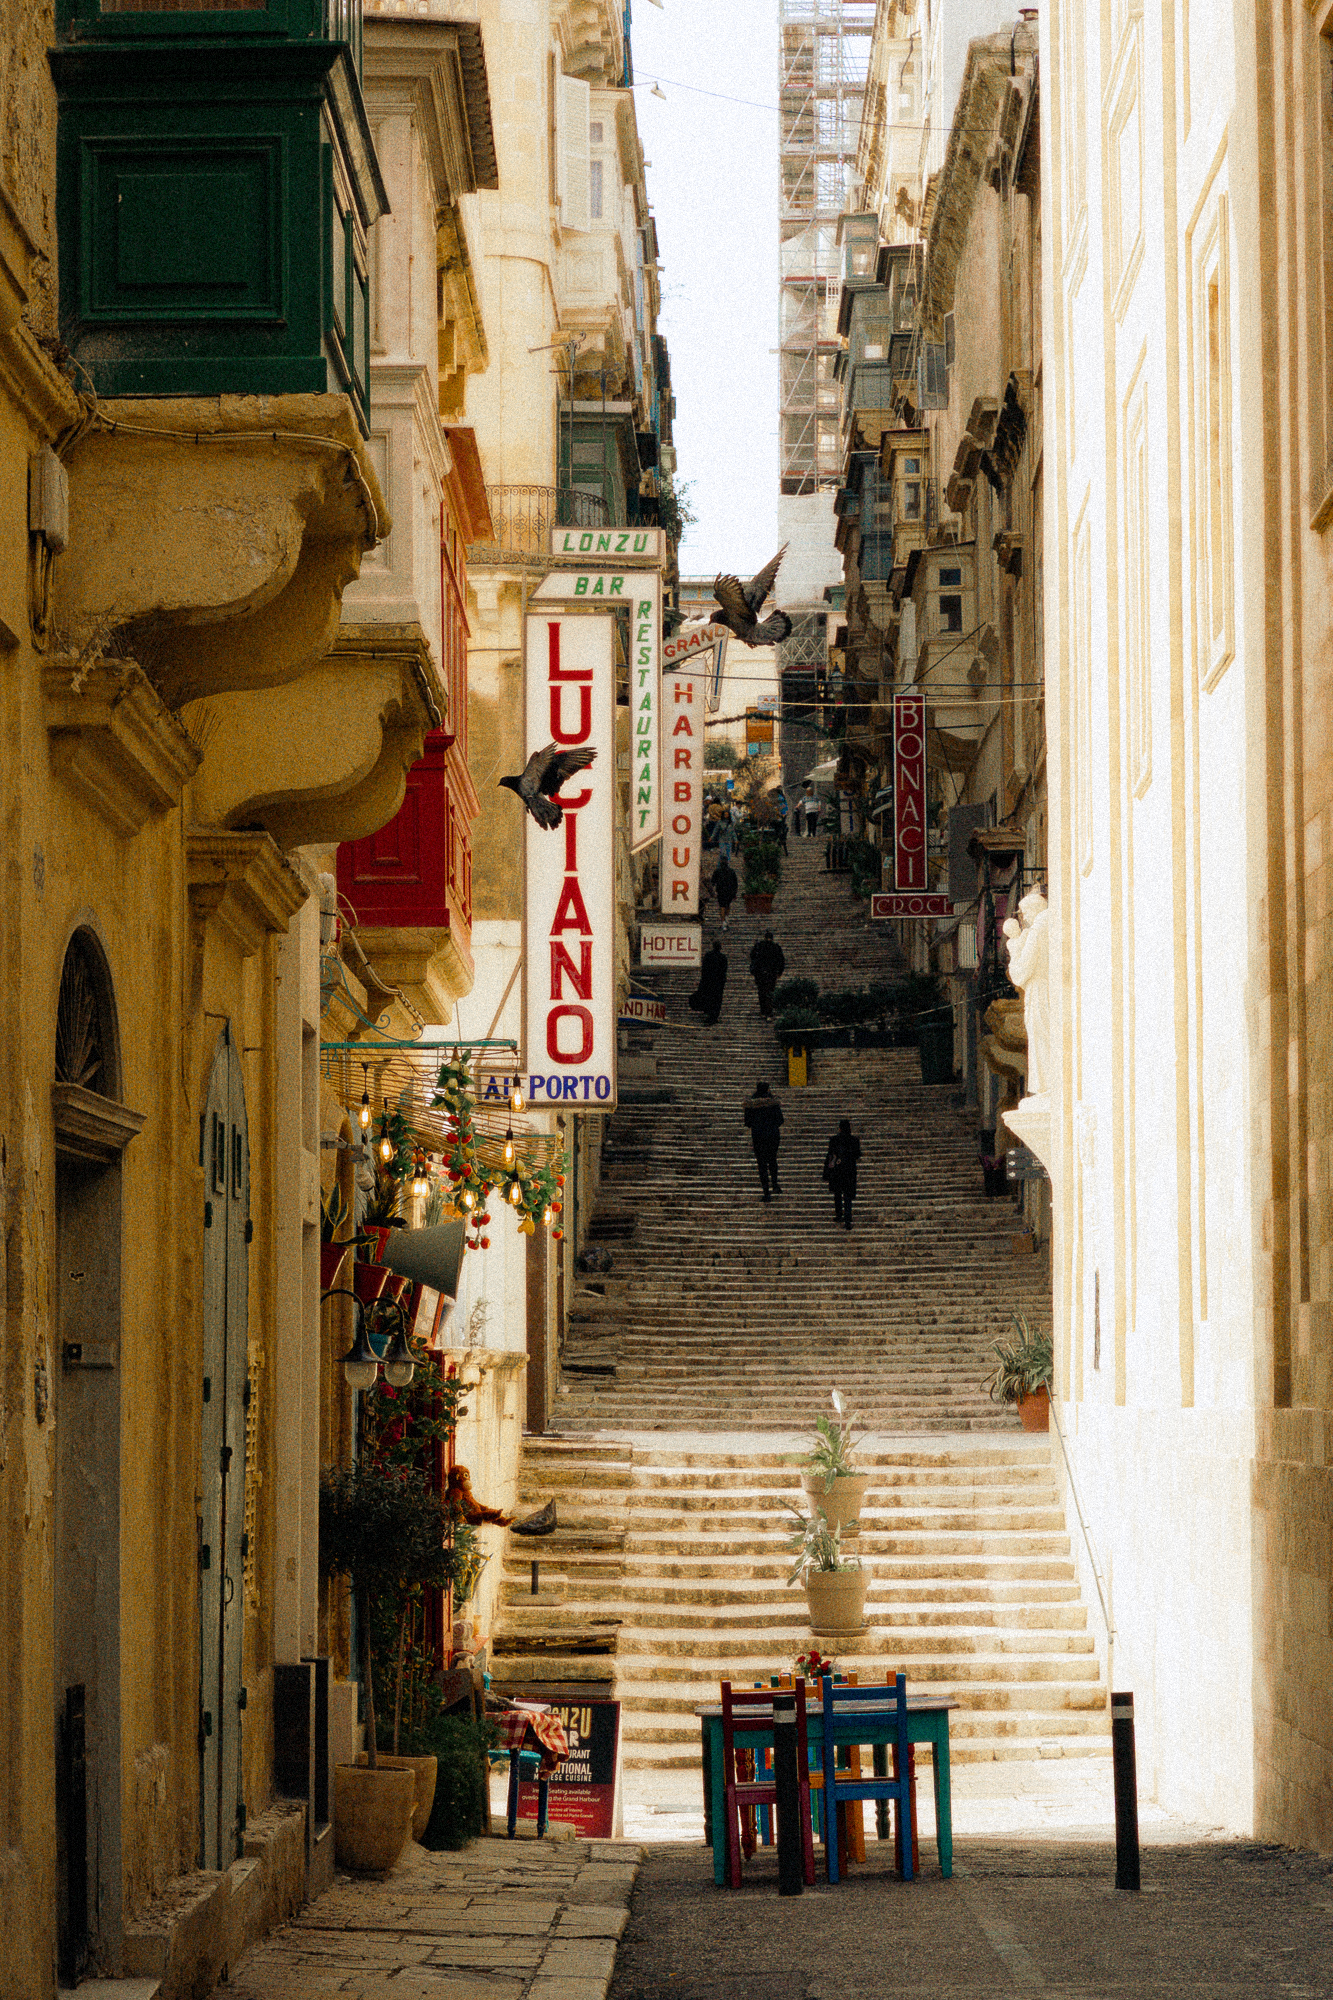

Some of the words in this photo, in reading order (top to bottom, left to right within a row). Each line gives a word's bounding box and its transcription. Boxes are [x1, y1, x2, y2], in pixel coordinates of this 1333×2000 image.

[562, 533, 648, 551] LONZU
[574, 577, 624, 595] BAR
[664, 625, 726, 657] GRAND
[636, 601, 652, 828] RESTAURANT
[672, 683, 693, 901] HARBOUR
[897, 700, 923, 883] BONACI
[643, 936, 698, 952] HOTEL
[529, 1075, 611, 1099] PORTO
[566, 1774, 592, 1782] CUISINE
